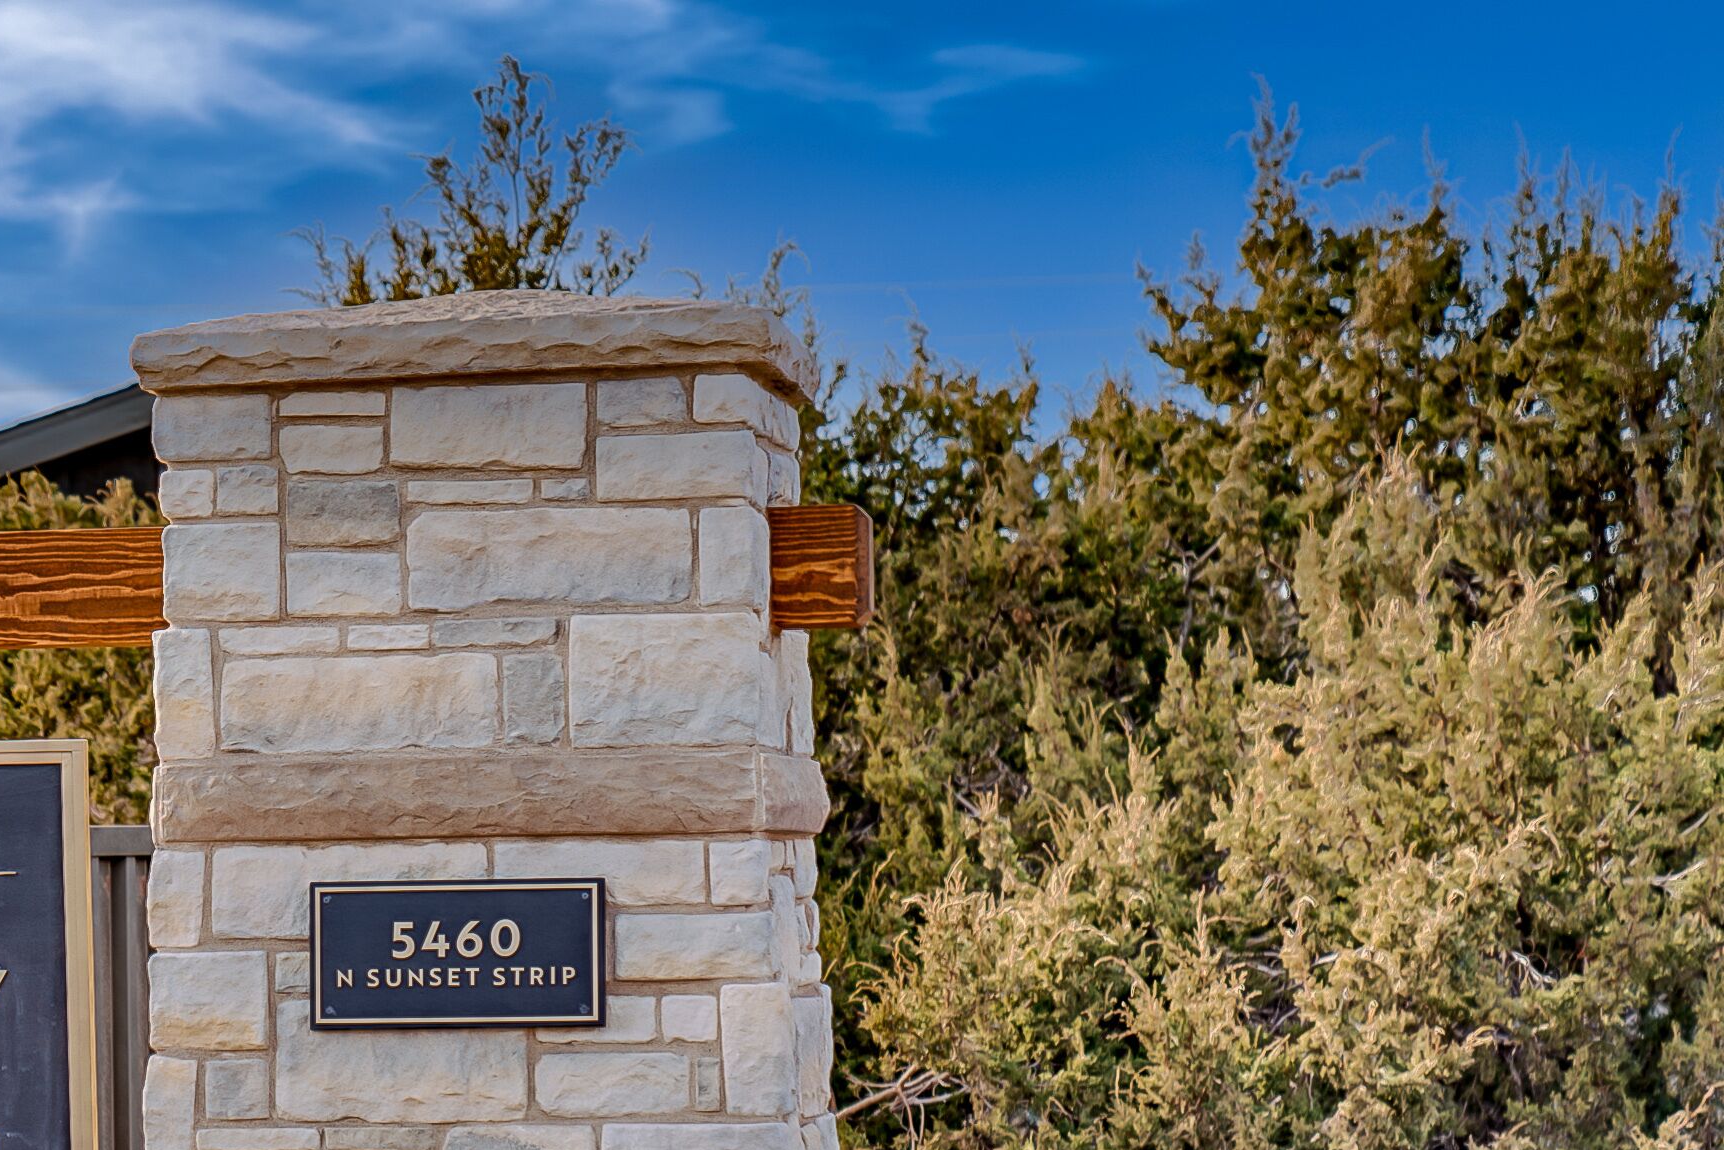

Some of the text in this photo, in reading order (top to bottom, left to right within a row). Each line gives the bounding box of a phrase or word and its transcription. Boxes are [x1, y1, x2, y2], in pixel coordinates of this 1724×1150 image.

[392, 918, 521, 959] 5460
[336, 966, 576, 987] N SUNSET STRIP
